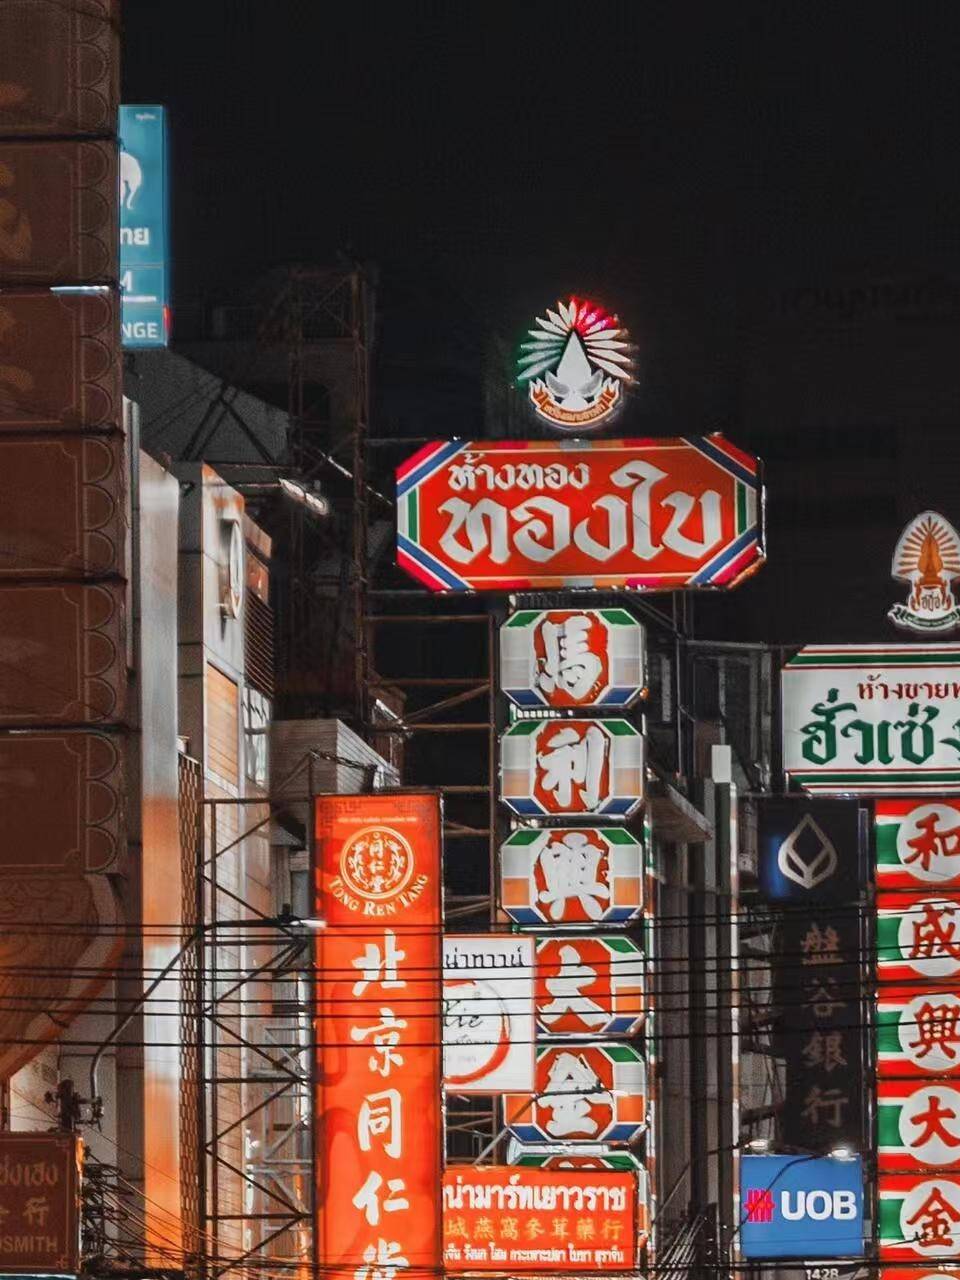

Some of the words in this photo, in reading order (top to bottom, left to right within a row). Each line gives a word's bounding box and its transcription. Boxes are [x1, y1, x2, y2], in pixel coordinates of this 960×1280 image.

[122, 323, 158, 338] NGE
[449, 454, 590, 491] ห้างทอง
[438, 460, 724, 565] ทองใบ
[443, 946, 524, 969] น่าทาวน์
[443, 1174, 626, 1211] น่ามาร์ทเยาวราช
[781, 1190, 857, 1221] UOB
[4, 1236, 58, 1253] SMITH
